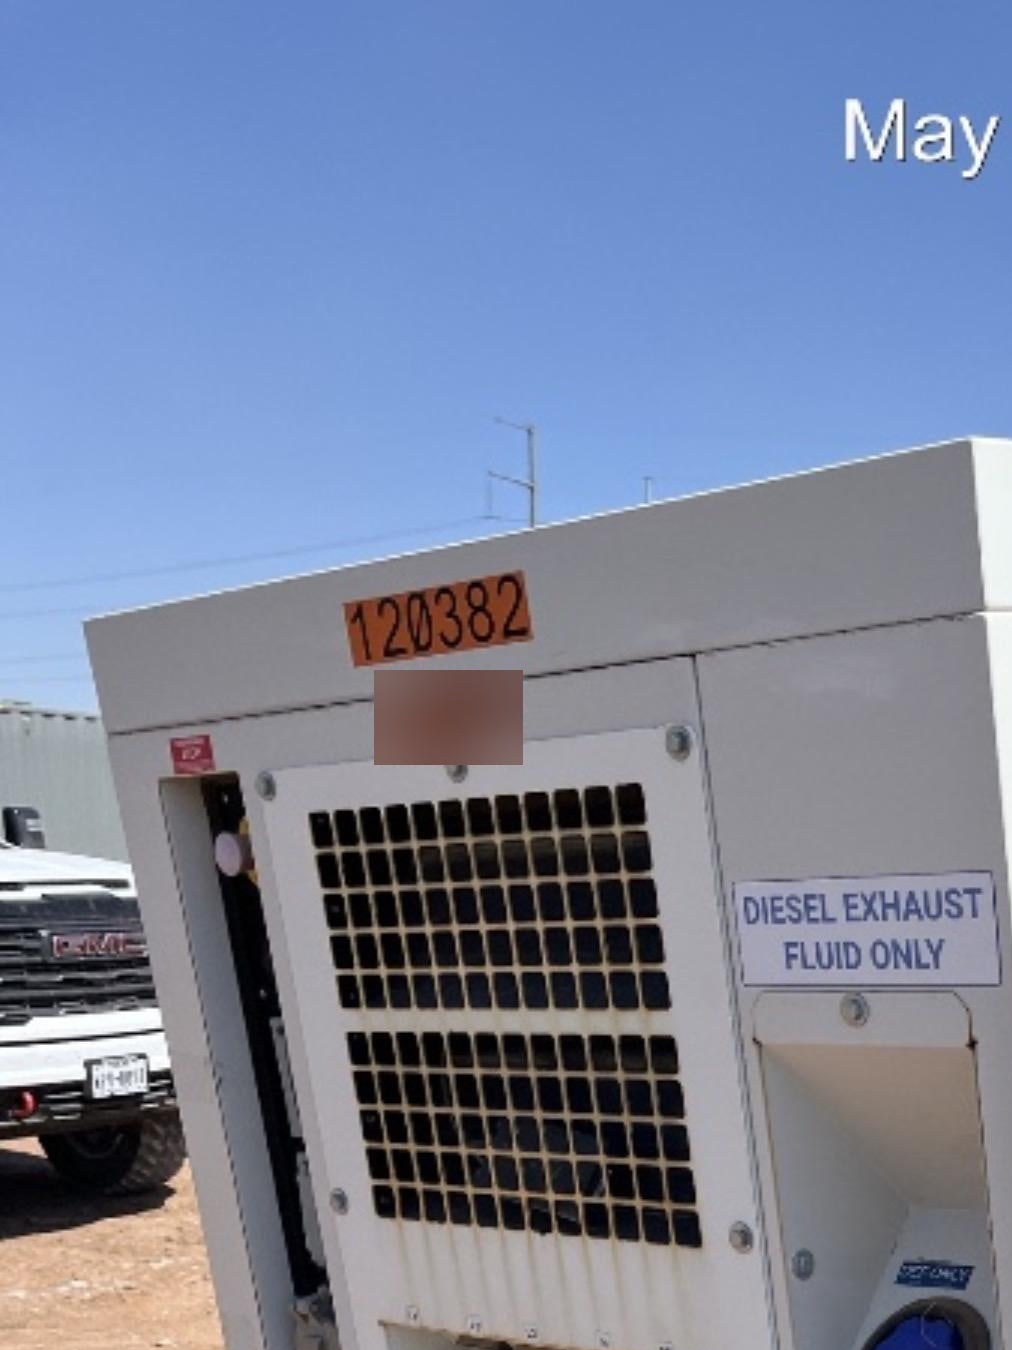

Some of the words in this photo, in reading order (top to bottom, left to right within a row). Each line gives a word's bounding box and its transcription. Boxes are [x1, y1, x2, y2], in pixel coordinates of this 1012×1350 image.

[351, 574, 529, 660] 120382
[743, 893, 838, 925] DIESEL
[842, 887, 983, 923] EXHAUST
[784, 940, 863, 970] FLUID
[870, 938, 946, 970] ONLY
